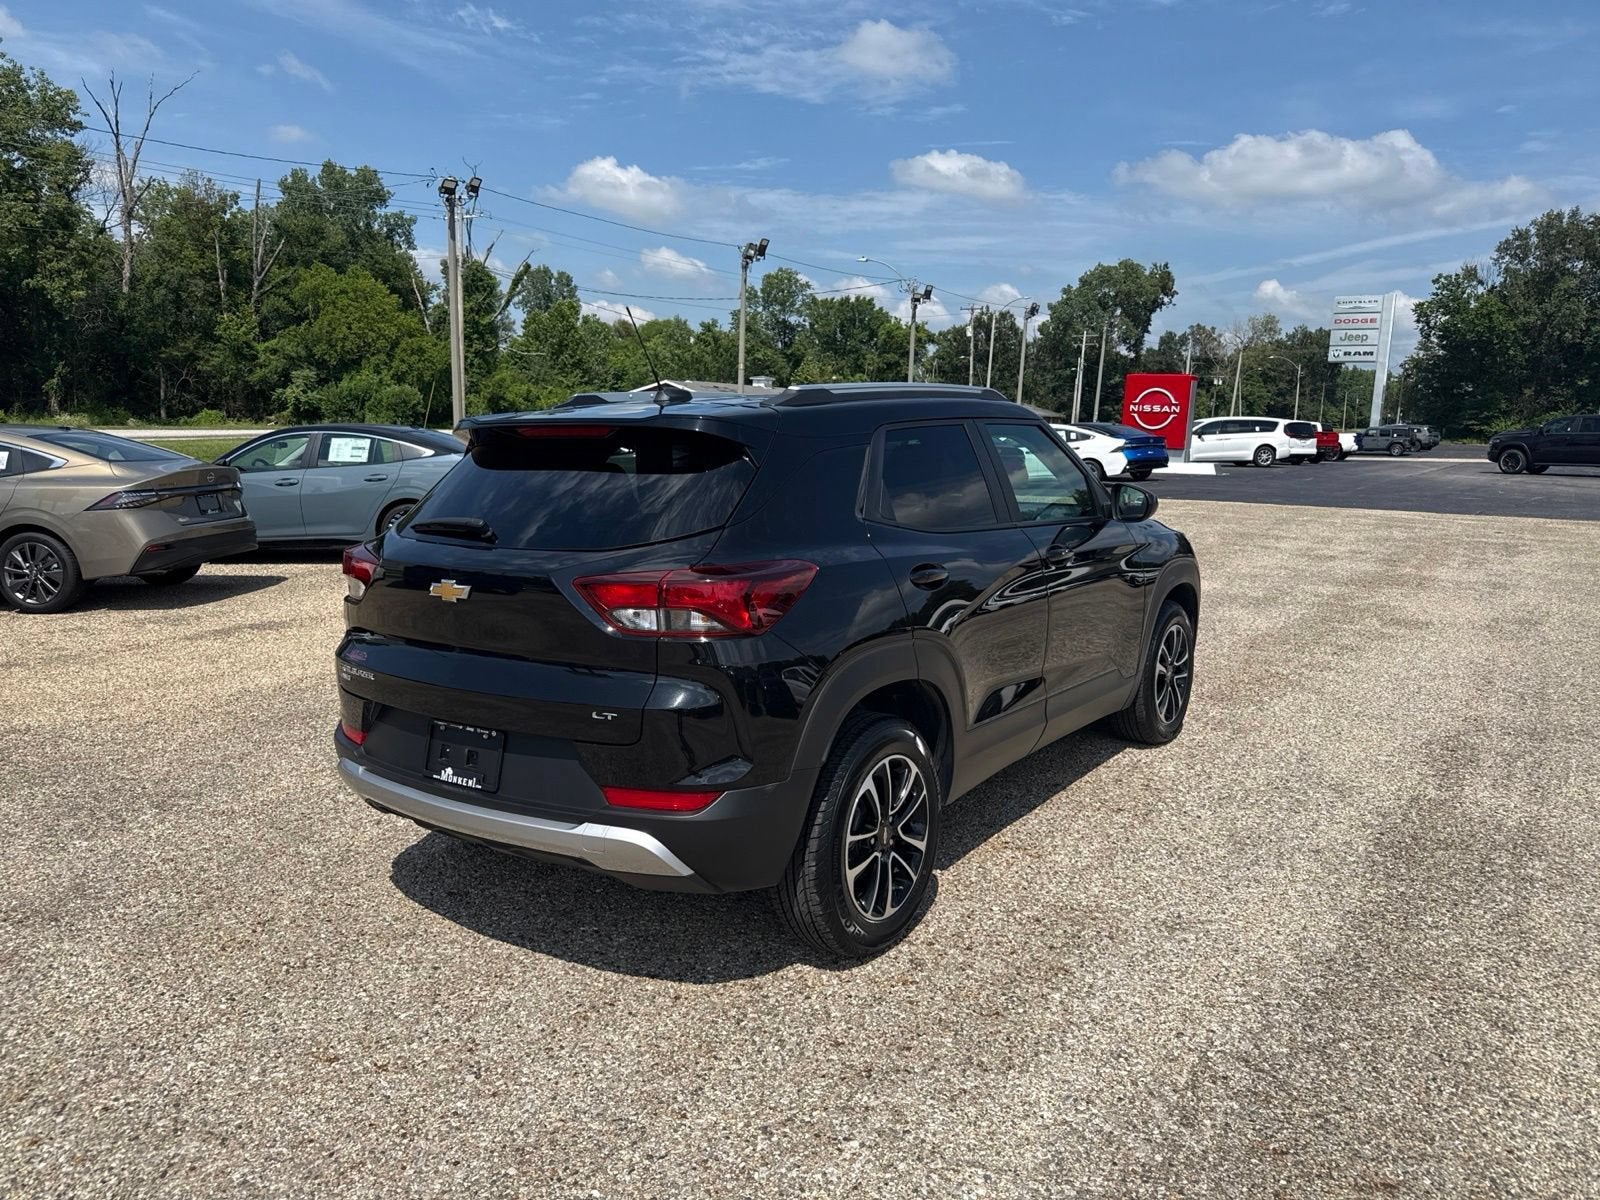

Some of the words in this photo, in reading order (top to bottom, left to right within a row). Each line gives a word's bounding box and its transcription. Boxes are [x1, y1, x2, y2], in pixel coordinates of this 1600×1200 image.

[1340, 332, 1368, 343] Jeep
[1129, 404, 1180, 413] NISSAN
[592, 711, 618, 720] LT
